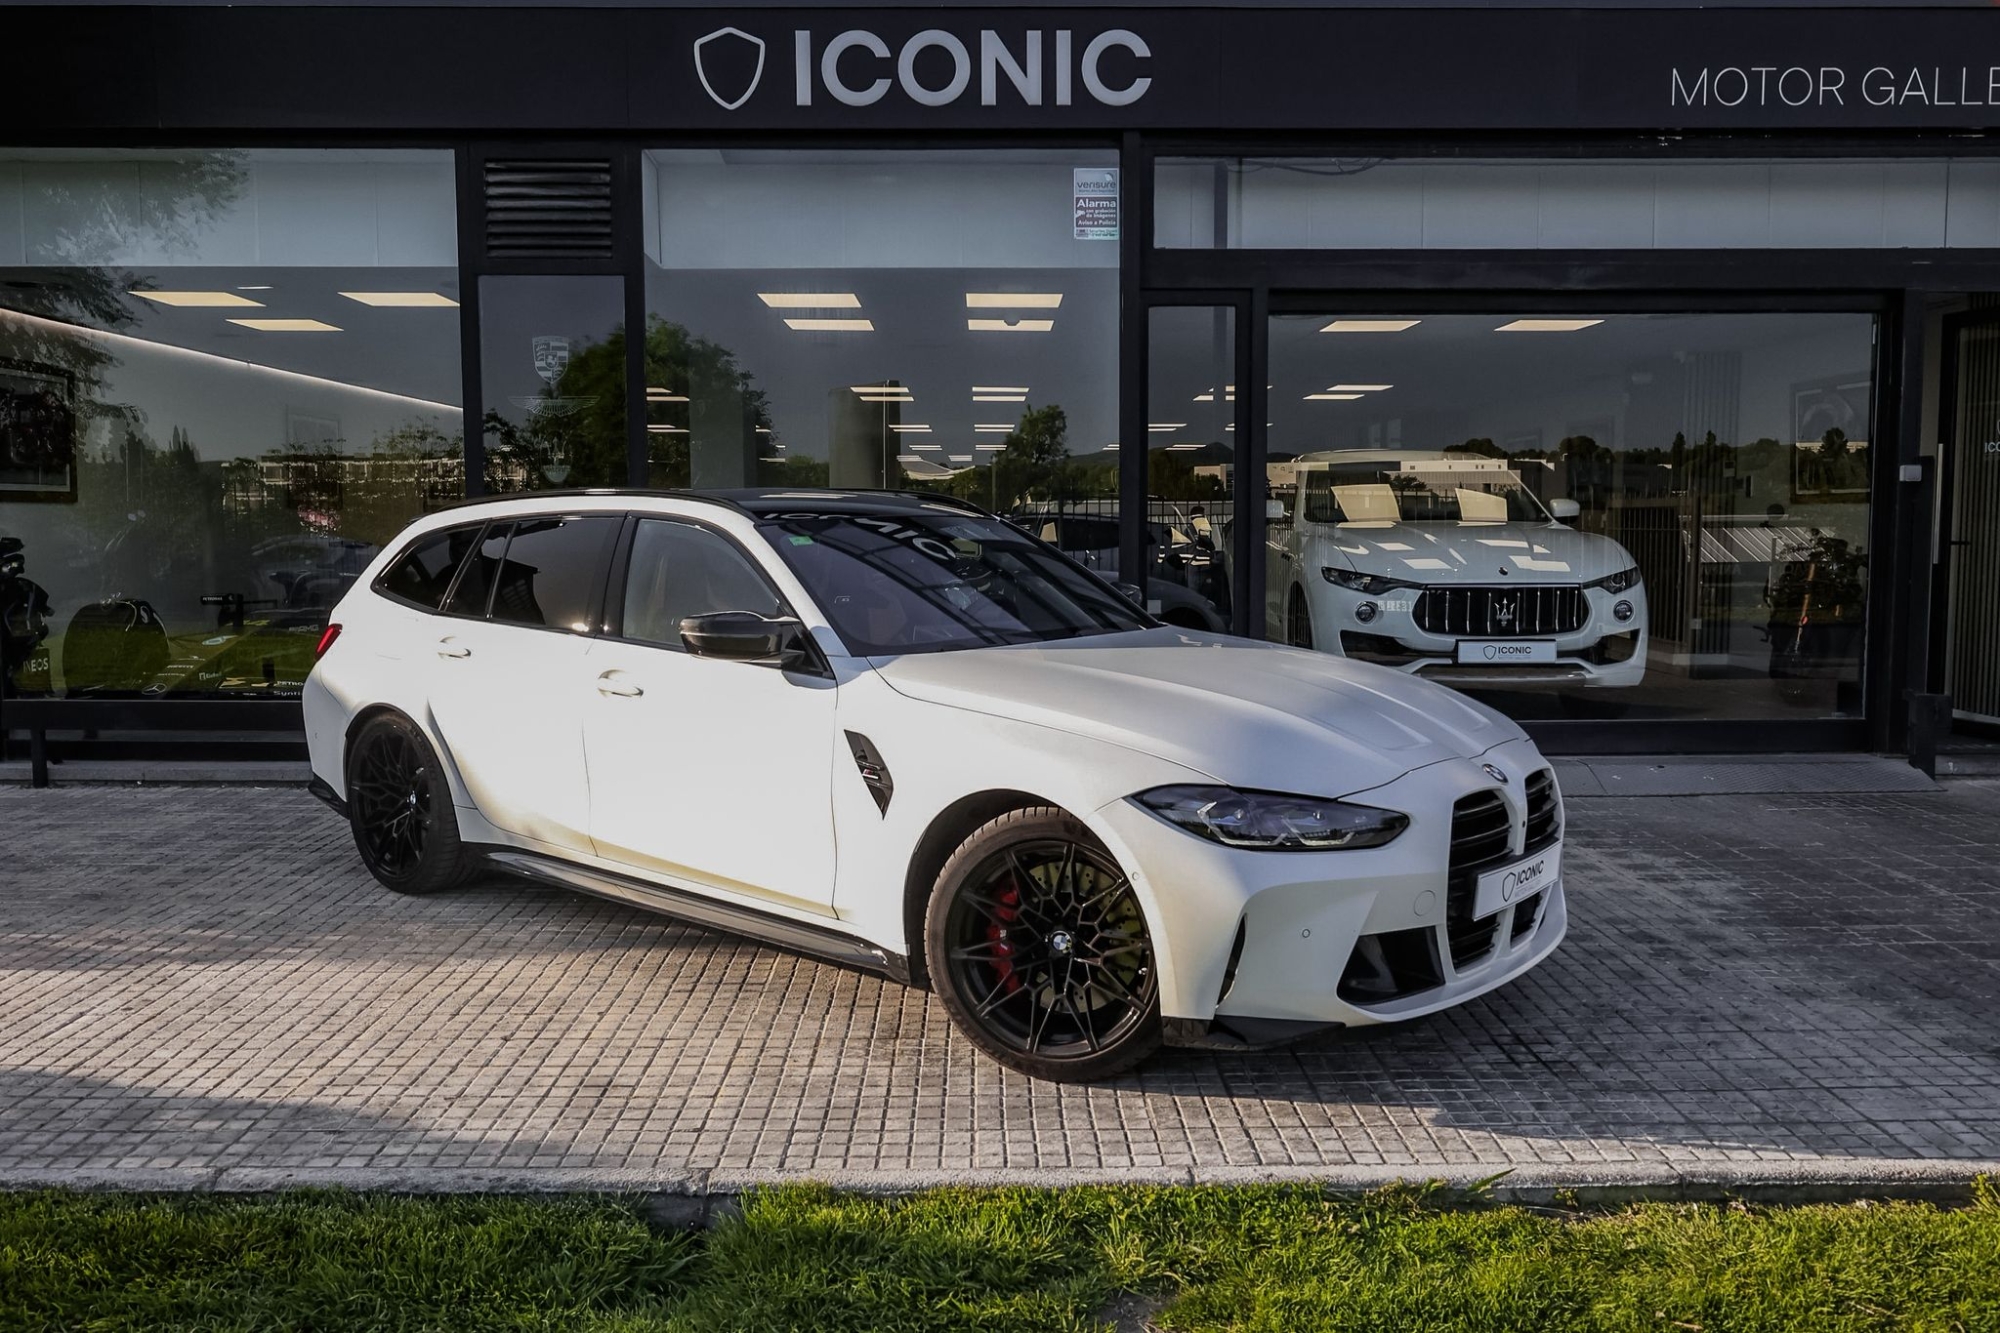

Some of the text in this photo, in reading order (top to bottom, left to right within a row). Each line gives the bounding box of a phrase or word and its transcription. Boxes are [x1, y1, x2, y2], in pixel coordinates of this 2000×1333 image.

[795, 29, 1152, 106] ICONIC
[1671, 67, 1845, 106] MOTOR
[1077, 181, 1116, 189] verisure
[1077, 198, 1117, 208] Alarma
[1498, 646, 1532, 654] ICONIC
[23, 657, 49, 673] INEOS
[1516, 860, 1544, 886] ICONIC
